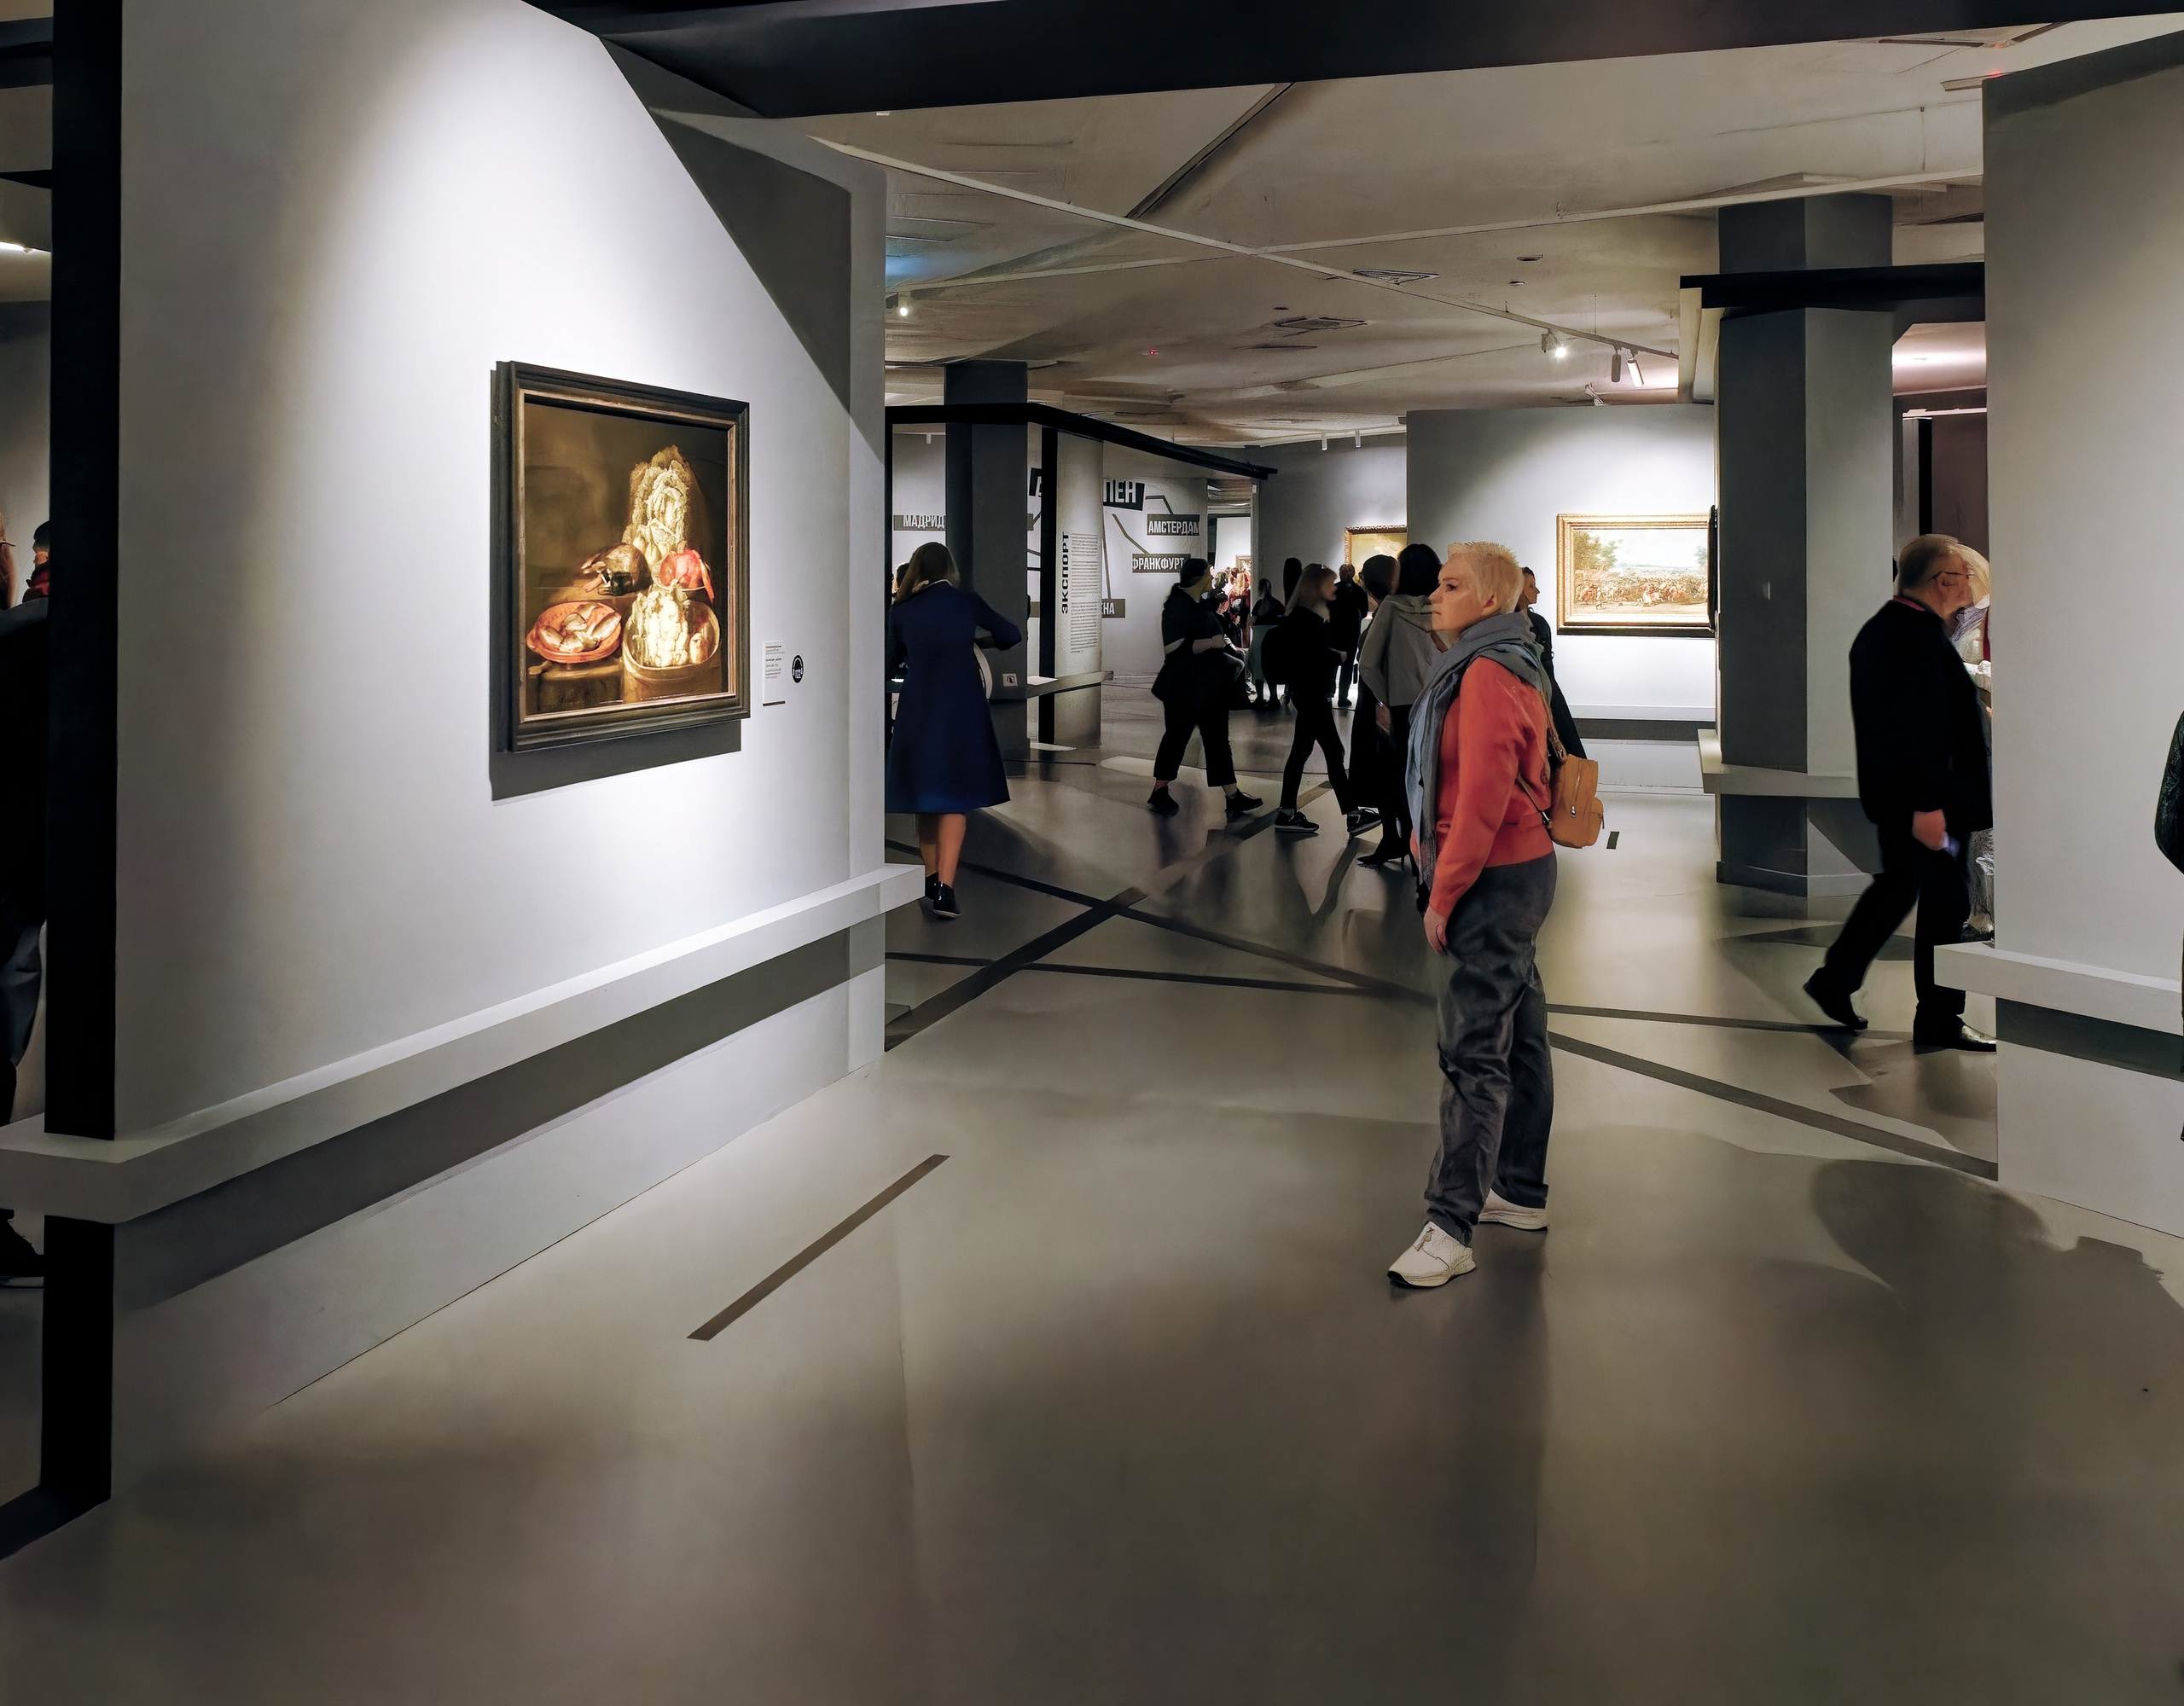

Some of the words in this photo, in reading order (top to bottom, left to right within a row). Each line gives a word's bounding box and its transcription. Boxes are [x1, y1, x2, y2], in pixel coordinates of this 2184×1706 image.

[903, 514, 945, 529] МАДРИД
[1131, 557, 1185, 571] ФРАНКФУРТ
[1101, 601, 1115, 615] НА
